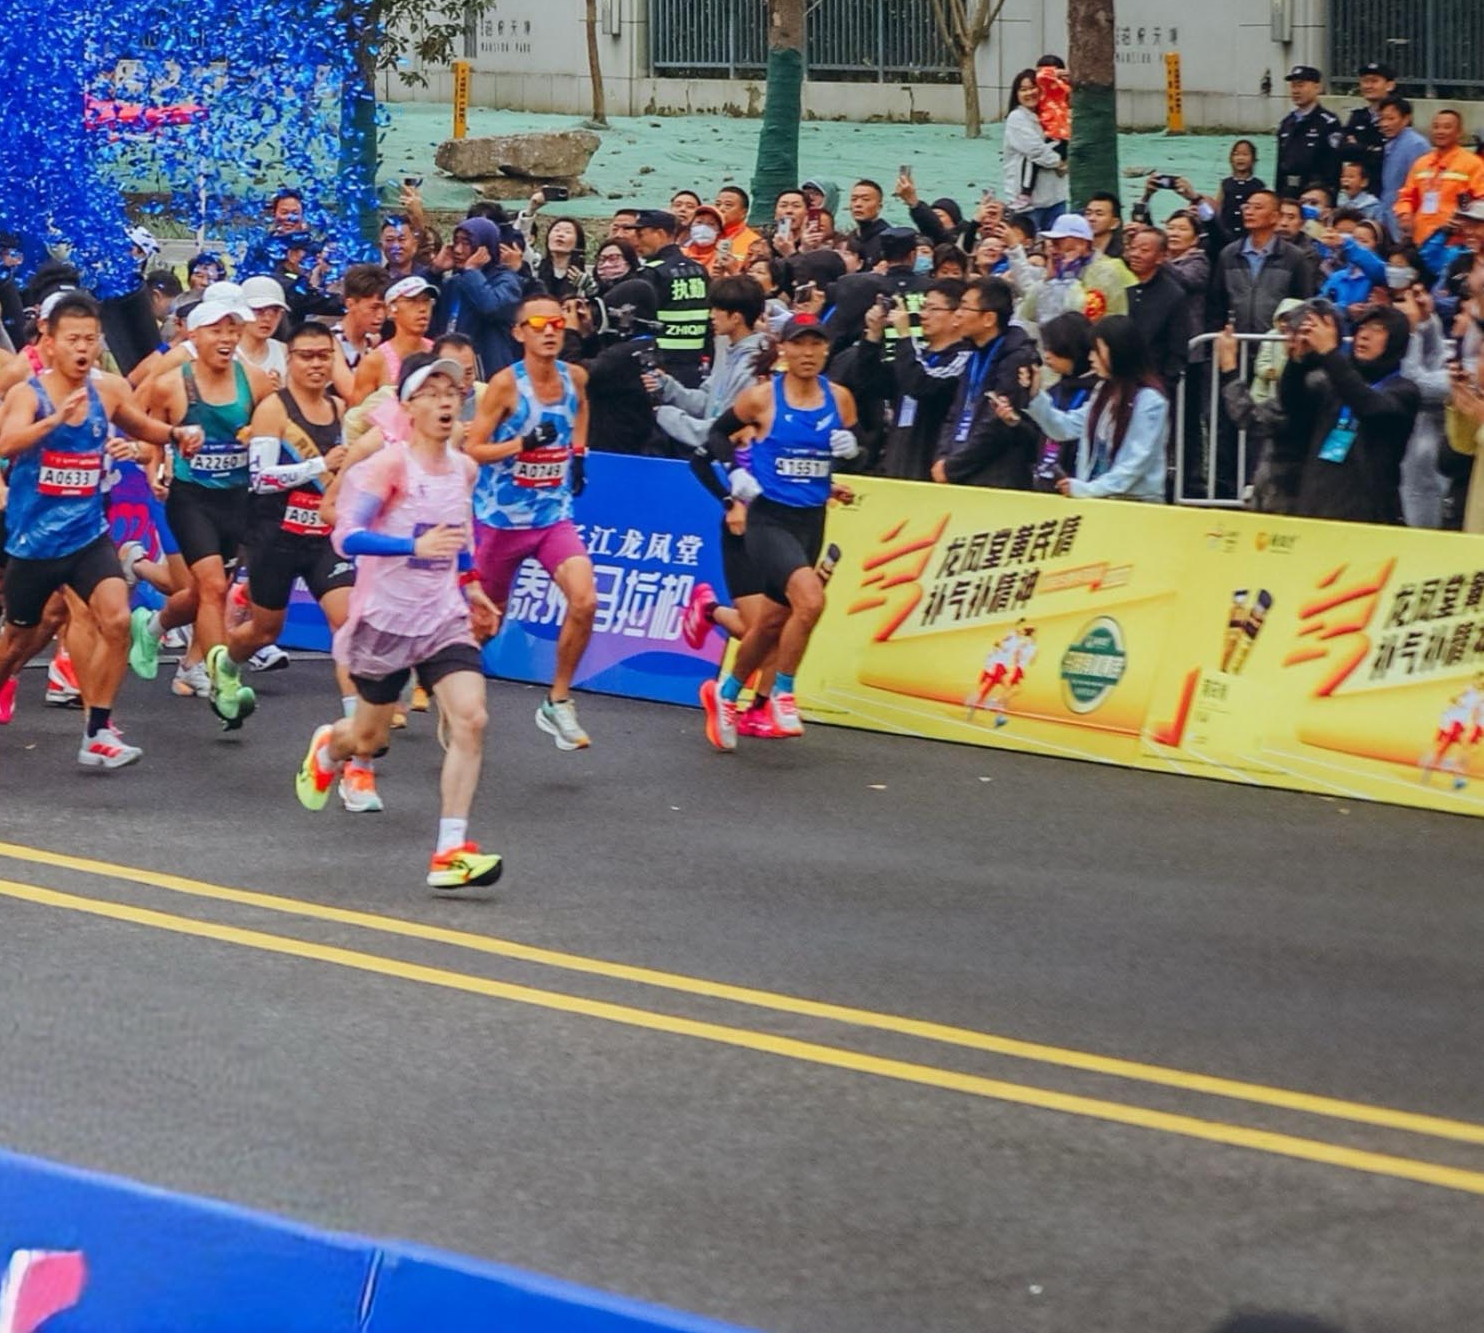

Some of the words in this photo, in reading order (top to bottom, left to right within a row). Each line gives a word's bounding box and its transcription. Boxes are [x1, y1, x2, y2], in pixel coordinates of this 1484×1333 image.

[671, 278, 706, 301] 执勤
[43, 470, 90, 486] A0633
[288, 510, 319, 525] A05
